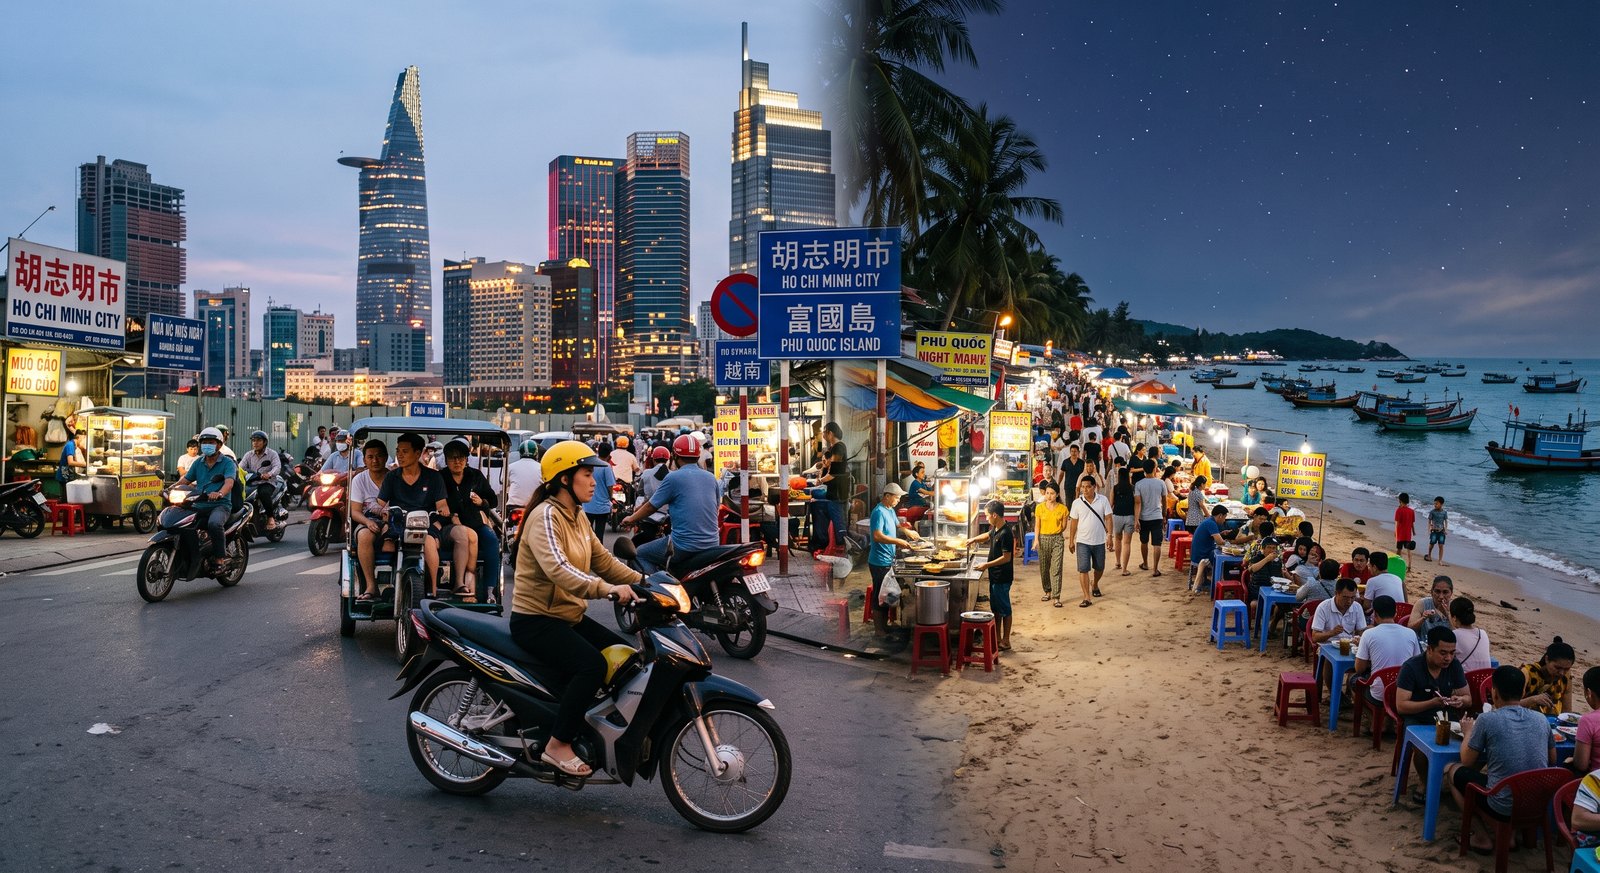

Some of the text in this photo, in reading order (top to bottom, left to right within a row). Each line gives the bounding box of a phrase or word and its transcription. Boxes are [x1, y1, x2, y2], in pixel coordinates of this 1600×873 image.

[771, 237, 893, 270] 胡志明市
[15, 250, 121, 305] 胡志明市
[782, 273, 880, 289] HO CHI MINH CITY
[13, 299, 121, 329] HO CHI MINH CITY
[787, 303, 876, 333] 富國島
[781, 337, 881, 352] PHU QUOC ISLAND
[919, 351, 950, 364] NIGHT
[724, 361, 761, 380] 越南
